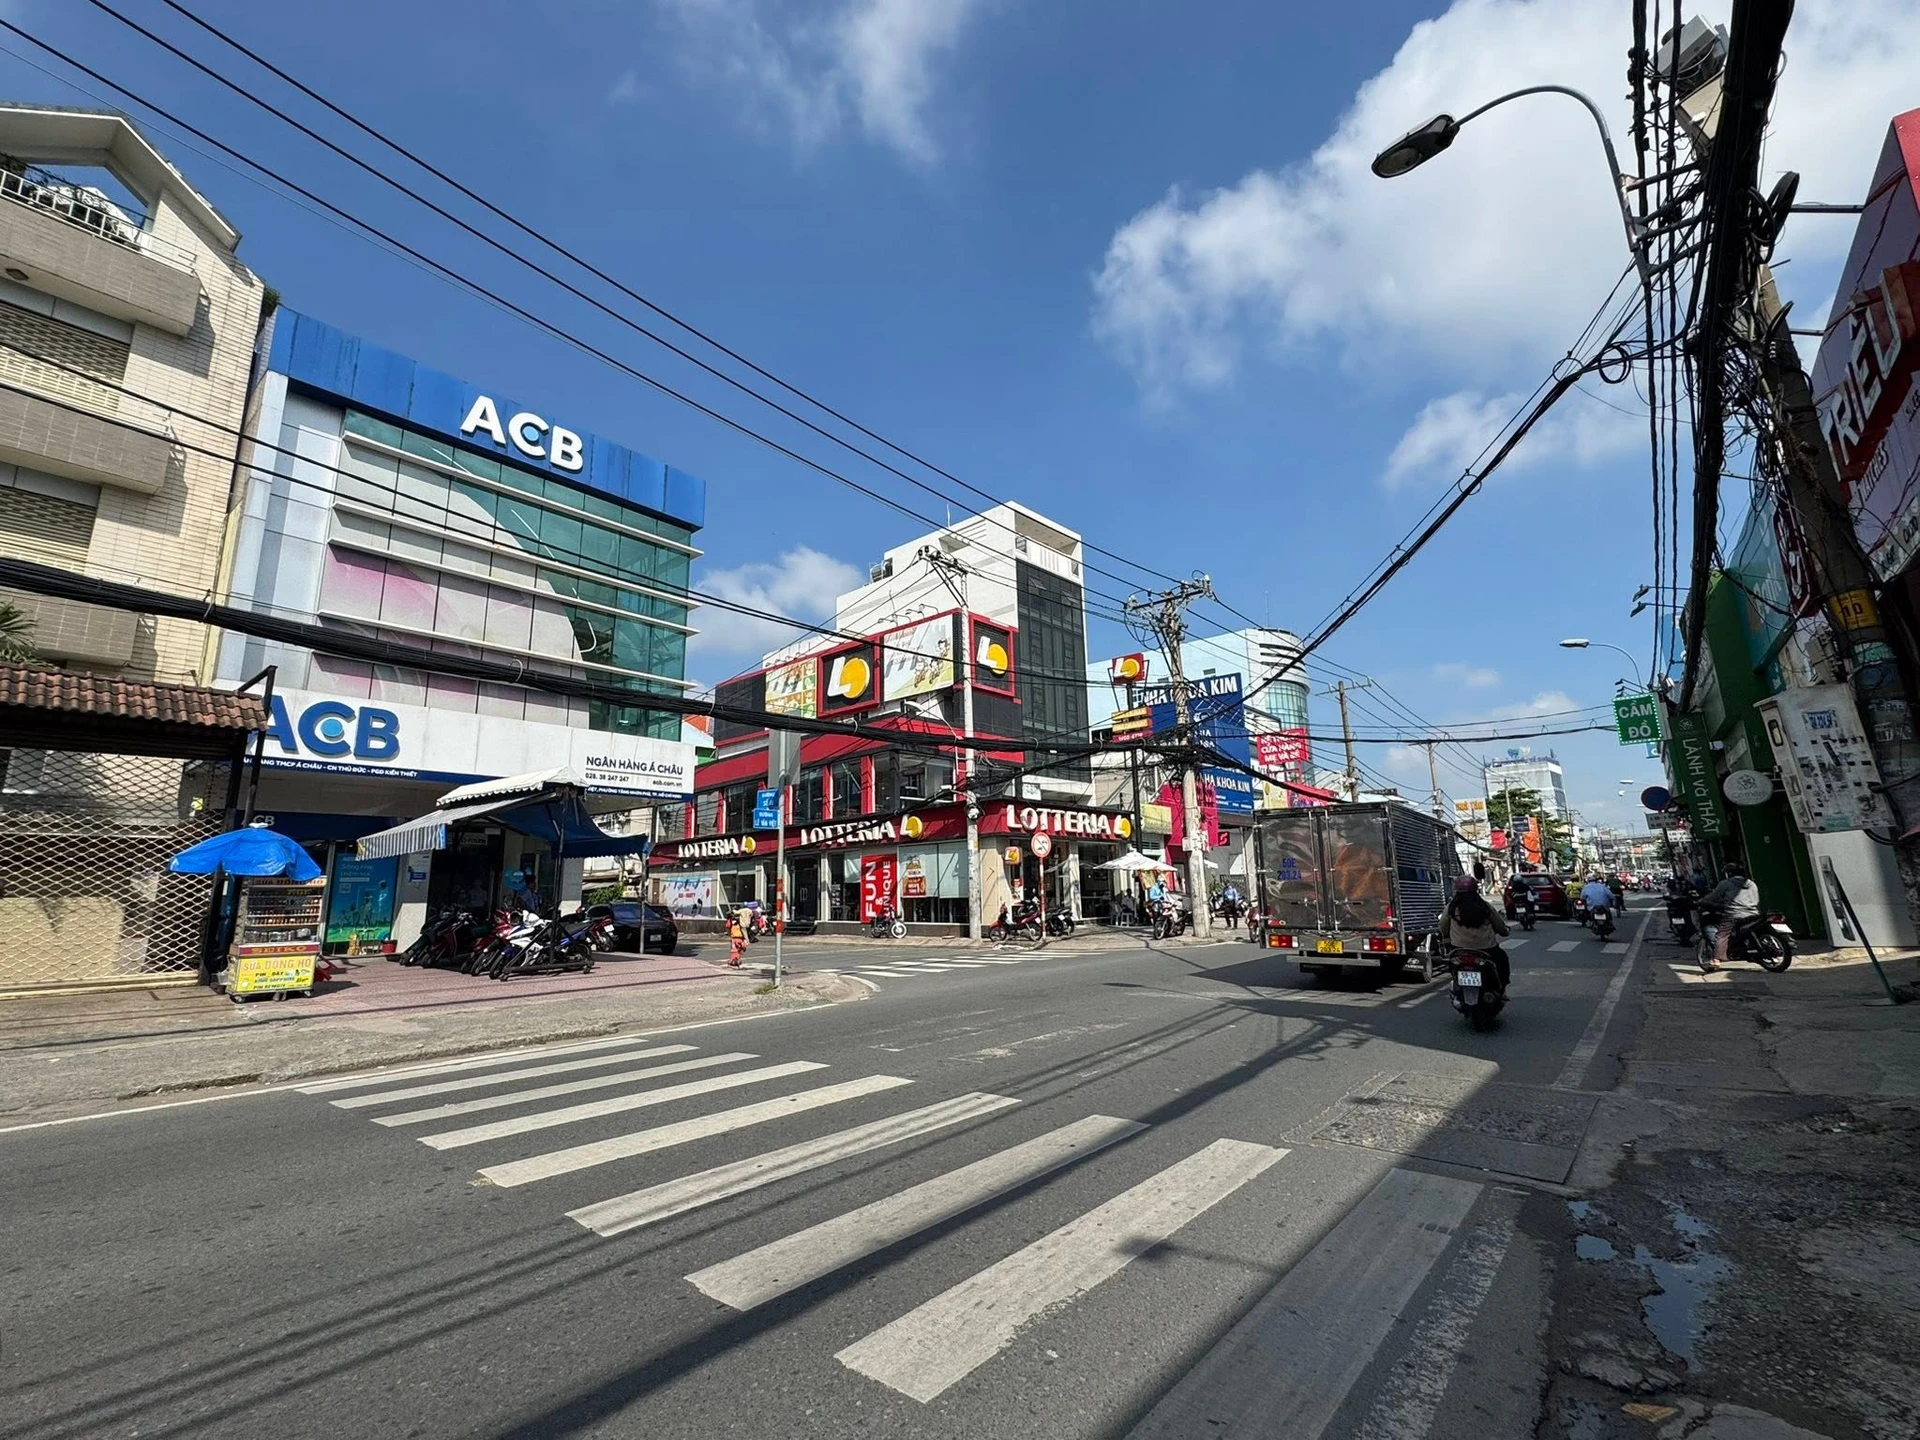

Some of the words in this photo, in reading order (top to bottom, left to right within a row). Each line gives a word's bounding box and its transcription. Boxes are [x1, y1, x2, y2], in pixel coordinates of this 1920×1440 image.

[460, 395, 583, 470] ACB
[1210, 676, 1238, 696] KIM
[1618, 699, 1652, 719] CẦM
[247, 693, 399, 758] ACB
[1628, 720, 1651, 738] ĐỒ
[586, 756, 616, 768] NGÂN
[618, 758, 647, 772] HÀNG
[649, 761, 656, 773] Á
[657, 763, 683, 775] CHÂU
[1682, 738, 1705, 776] LÀNH
[1216, 777, 1237, 791] KHOA
[1006, 804, 1112, 835] LOTTERIA
[801, 820, 896, 845] LOTTERIA
[678, 838, 739, 858] LOTTERIA
[865, 861, 876, 917] FUN
[251, 945, 307, 954] SEIKO
